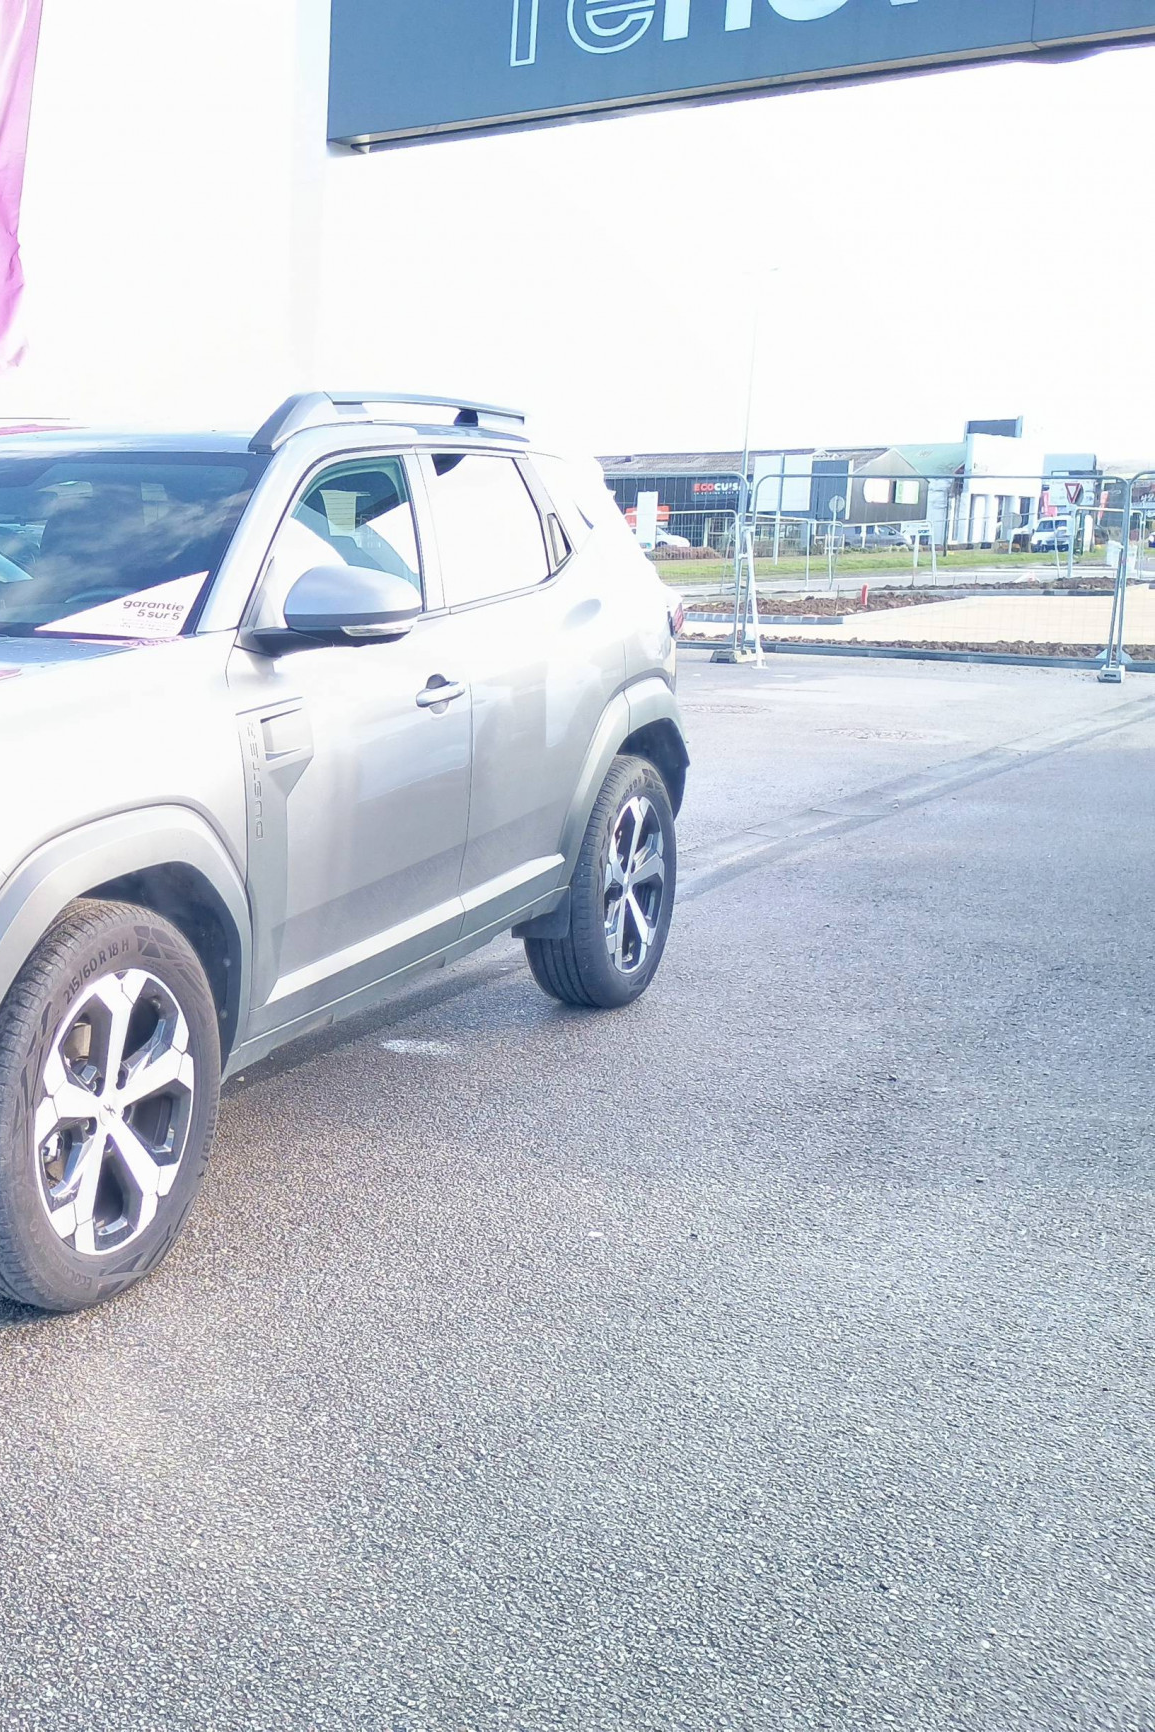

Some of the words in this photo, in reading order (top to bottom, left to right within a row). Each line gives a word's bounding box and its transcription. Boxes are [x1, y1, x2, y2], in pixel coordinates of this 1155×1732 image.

[123, 600, 184, 611] garantie
[137, 609, 146, 617] 5
[147, 611, 170, 619] sur
[171, 612, 180, 621] 5
[63, 957, 98, 1005] 215/60
[98, 950, 107, 965] R
[108, 942, 119, 959] 18
[121, 939, 129, 952] H
